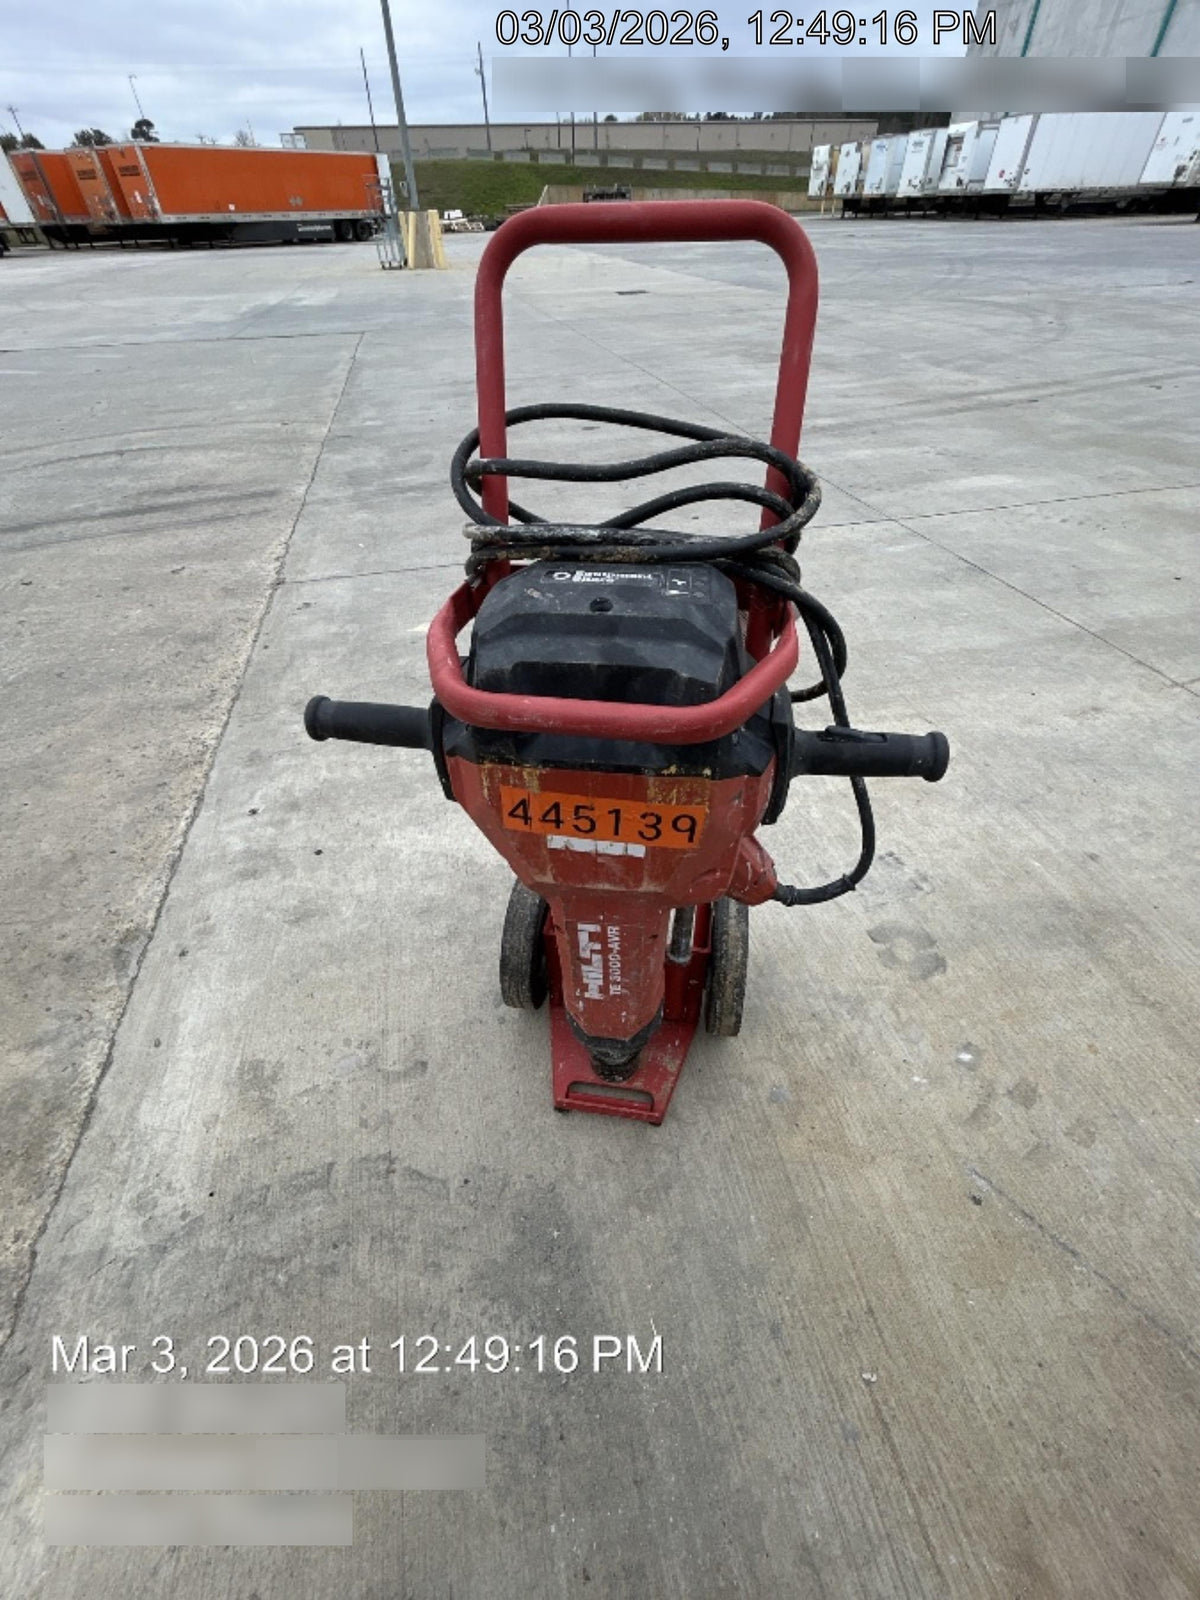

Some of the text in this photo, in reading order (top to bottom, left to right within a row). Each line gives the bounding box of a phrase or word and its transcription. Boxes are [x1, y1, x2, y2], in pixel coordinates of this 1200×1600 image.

[507, 797, 698, 844] 445139
[577, 923, 604, 1000] HILTI
[609, 984, 622, 997] TE
